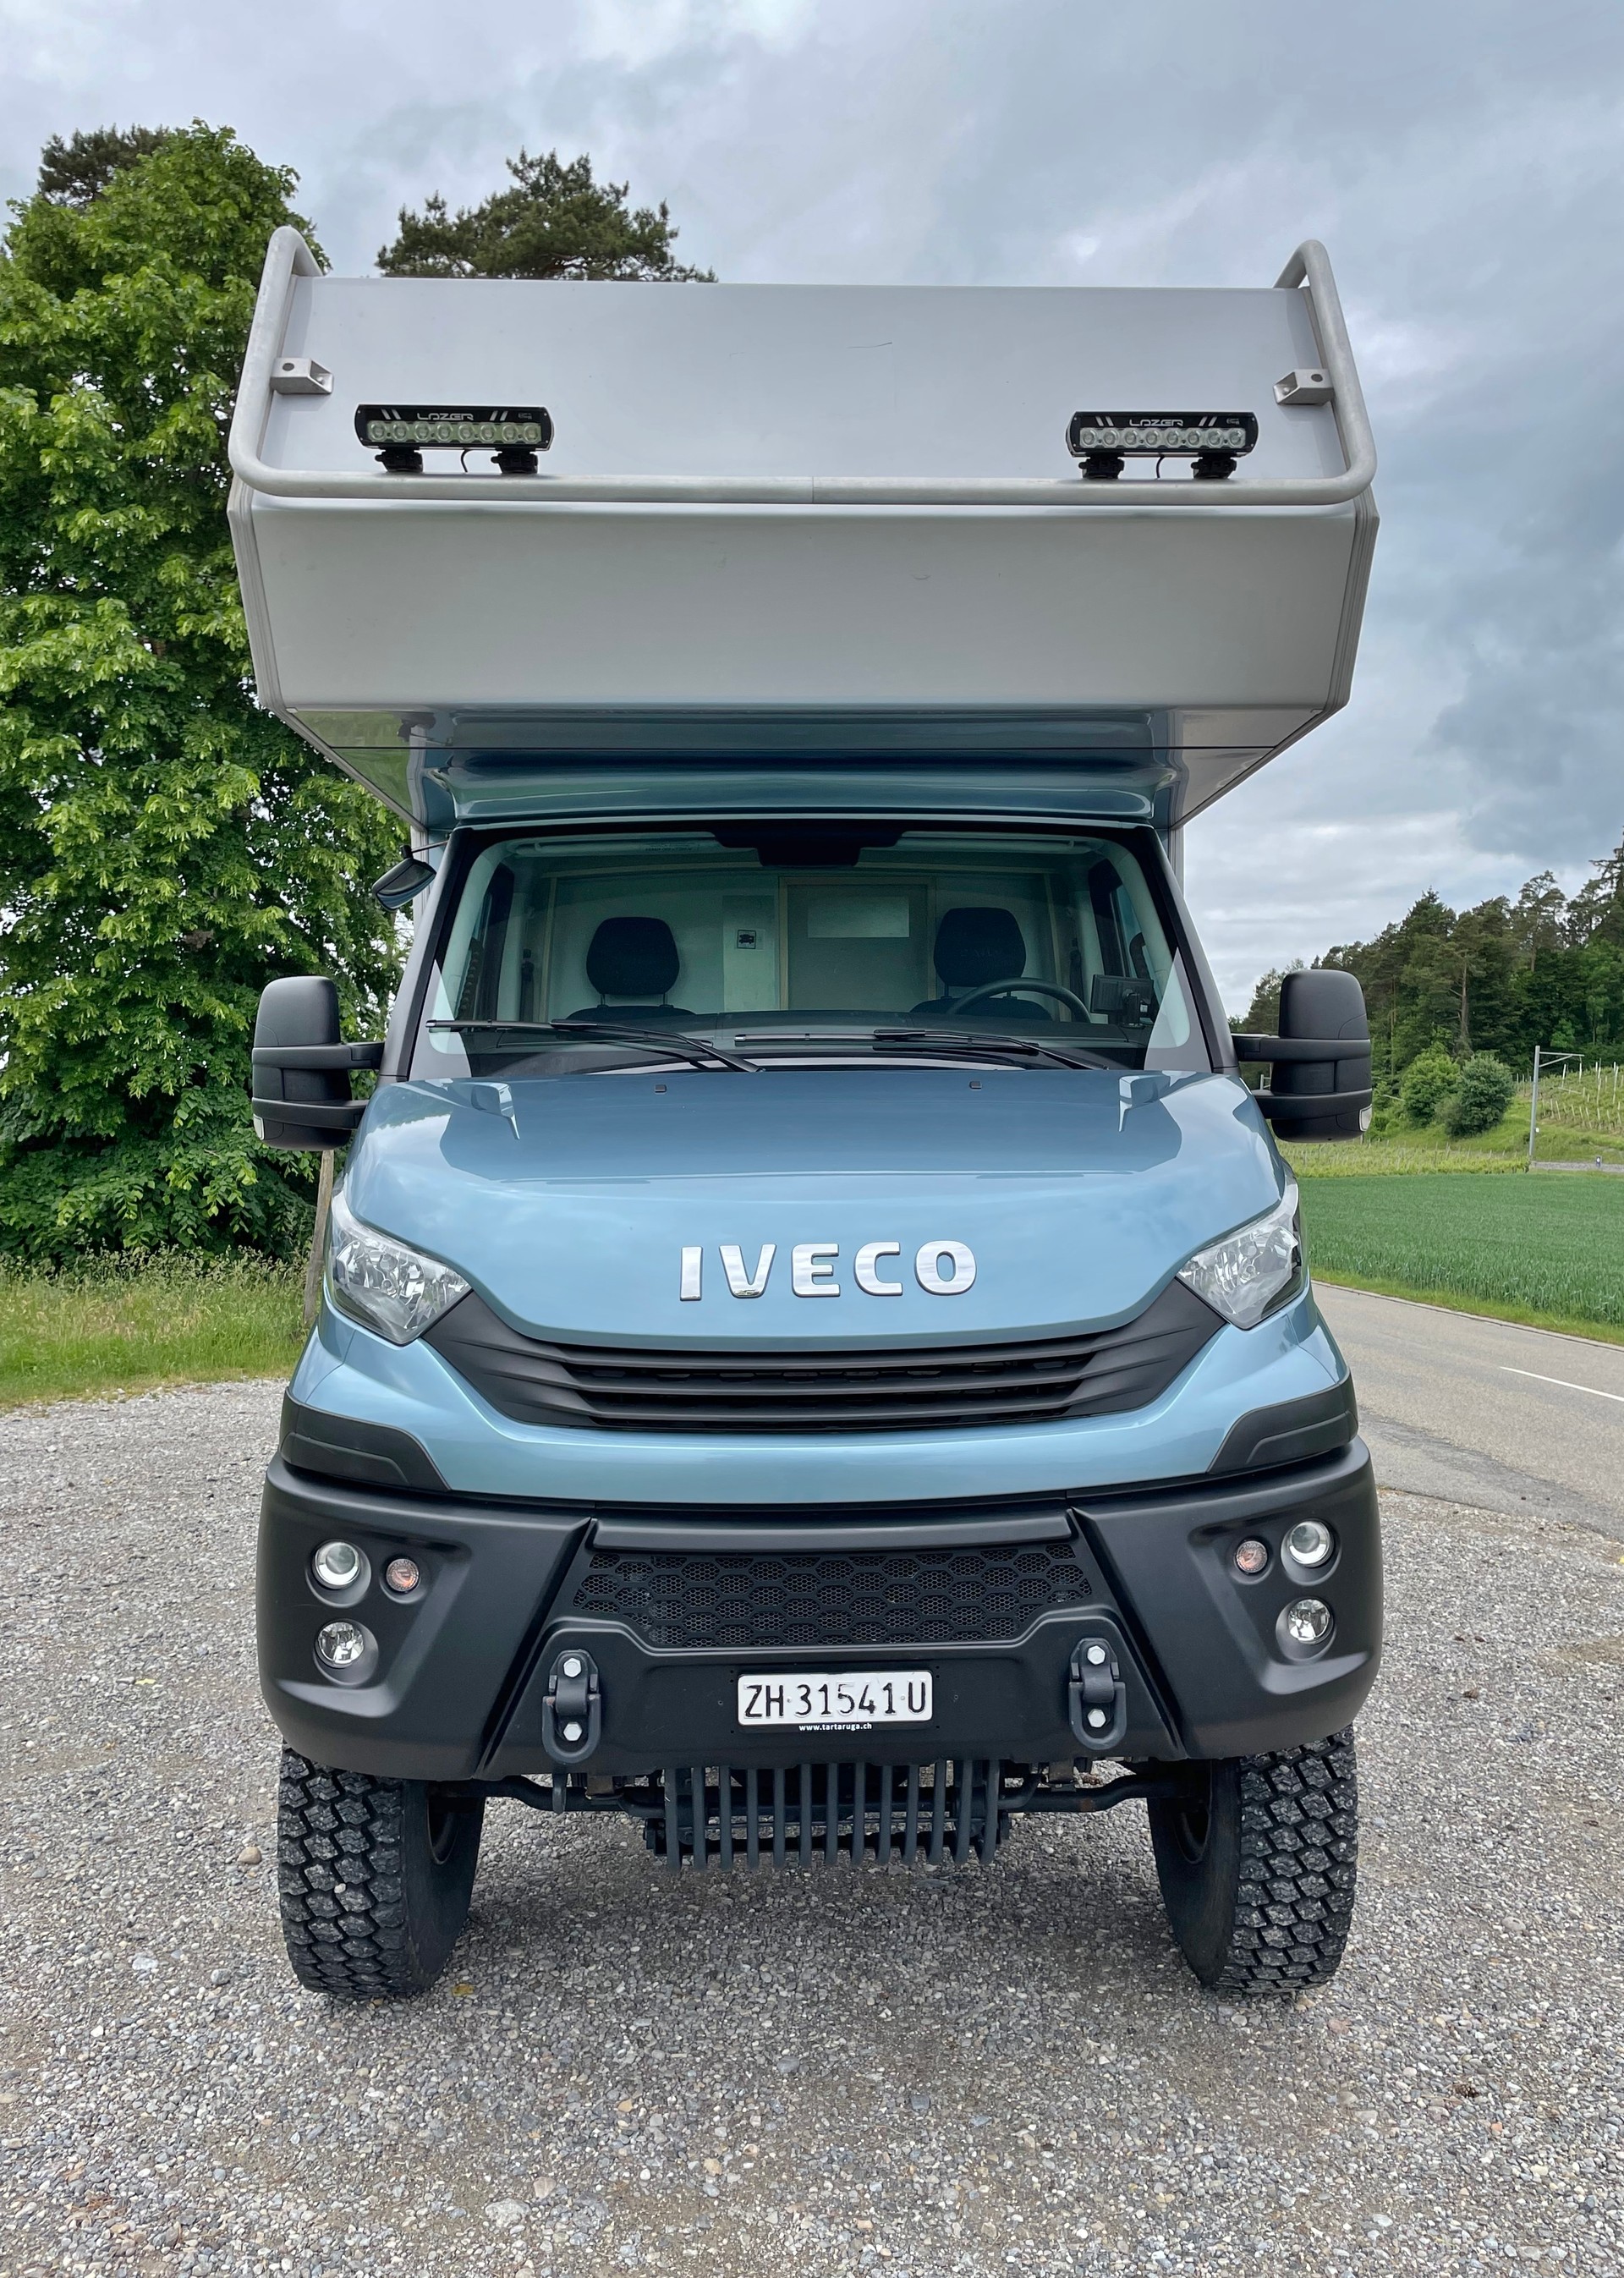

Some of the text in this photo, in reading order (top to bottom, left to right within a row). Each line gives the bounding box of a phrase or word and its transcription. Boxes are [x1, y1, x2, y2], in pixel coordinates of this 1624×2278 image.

[417, 412, 474, 421] LAZER
[1129, 419, 1183, 427] LAZER
[679, 1240, 977, 1301] IVECO
[798, 1722, 872, 1732] www.tartaruga.ch
